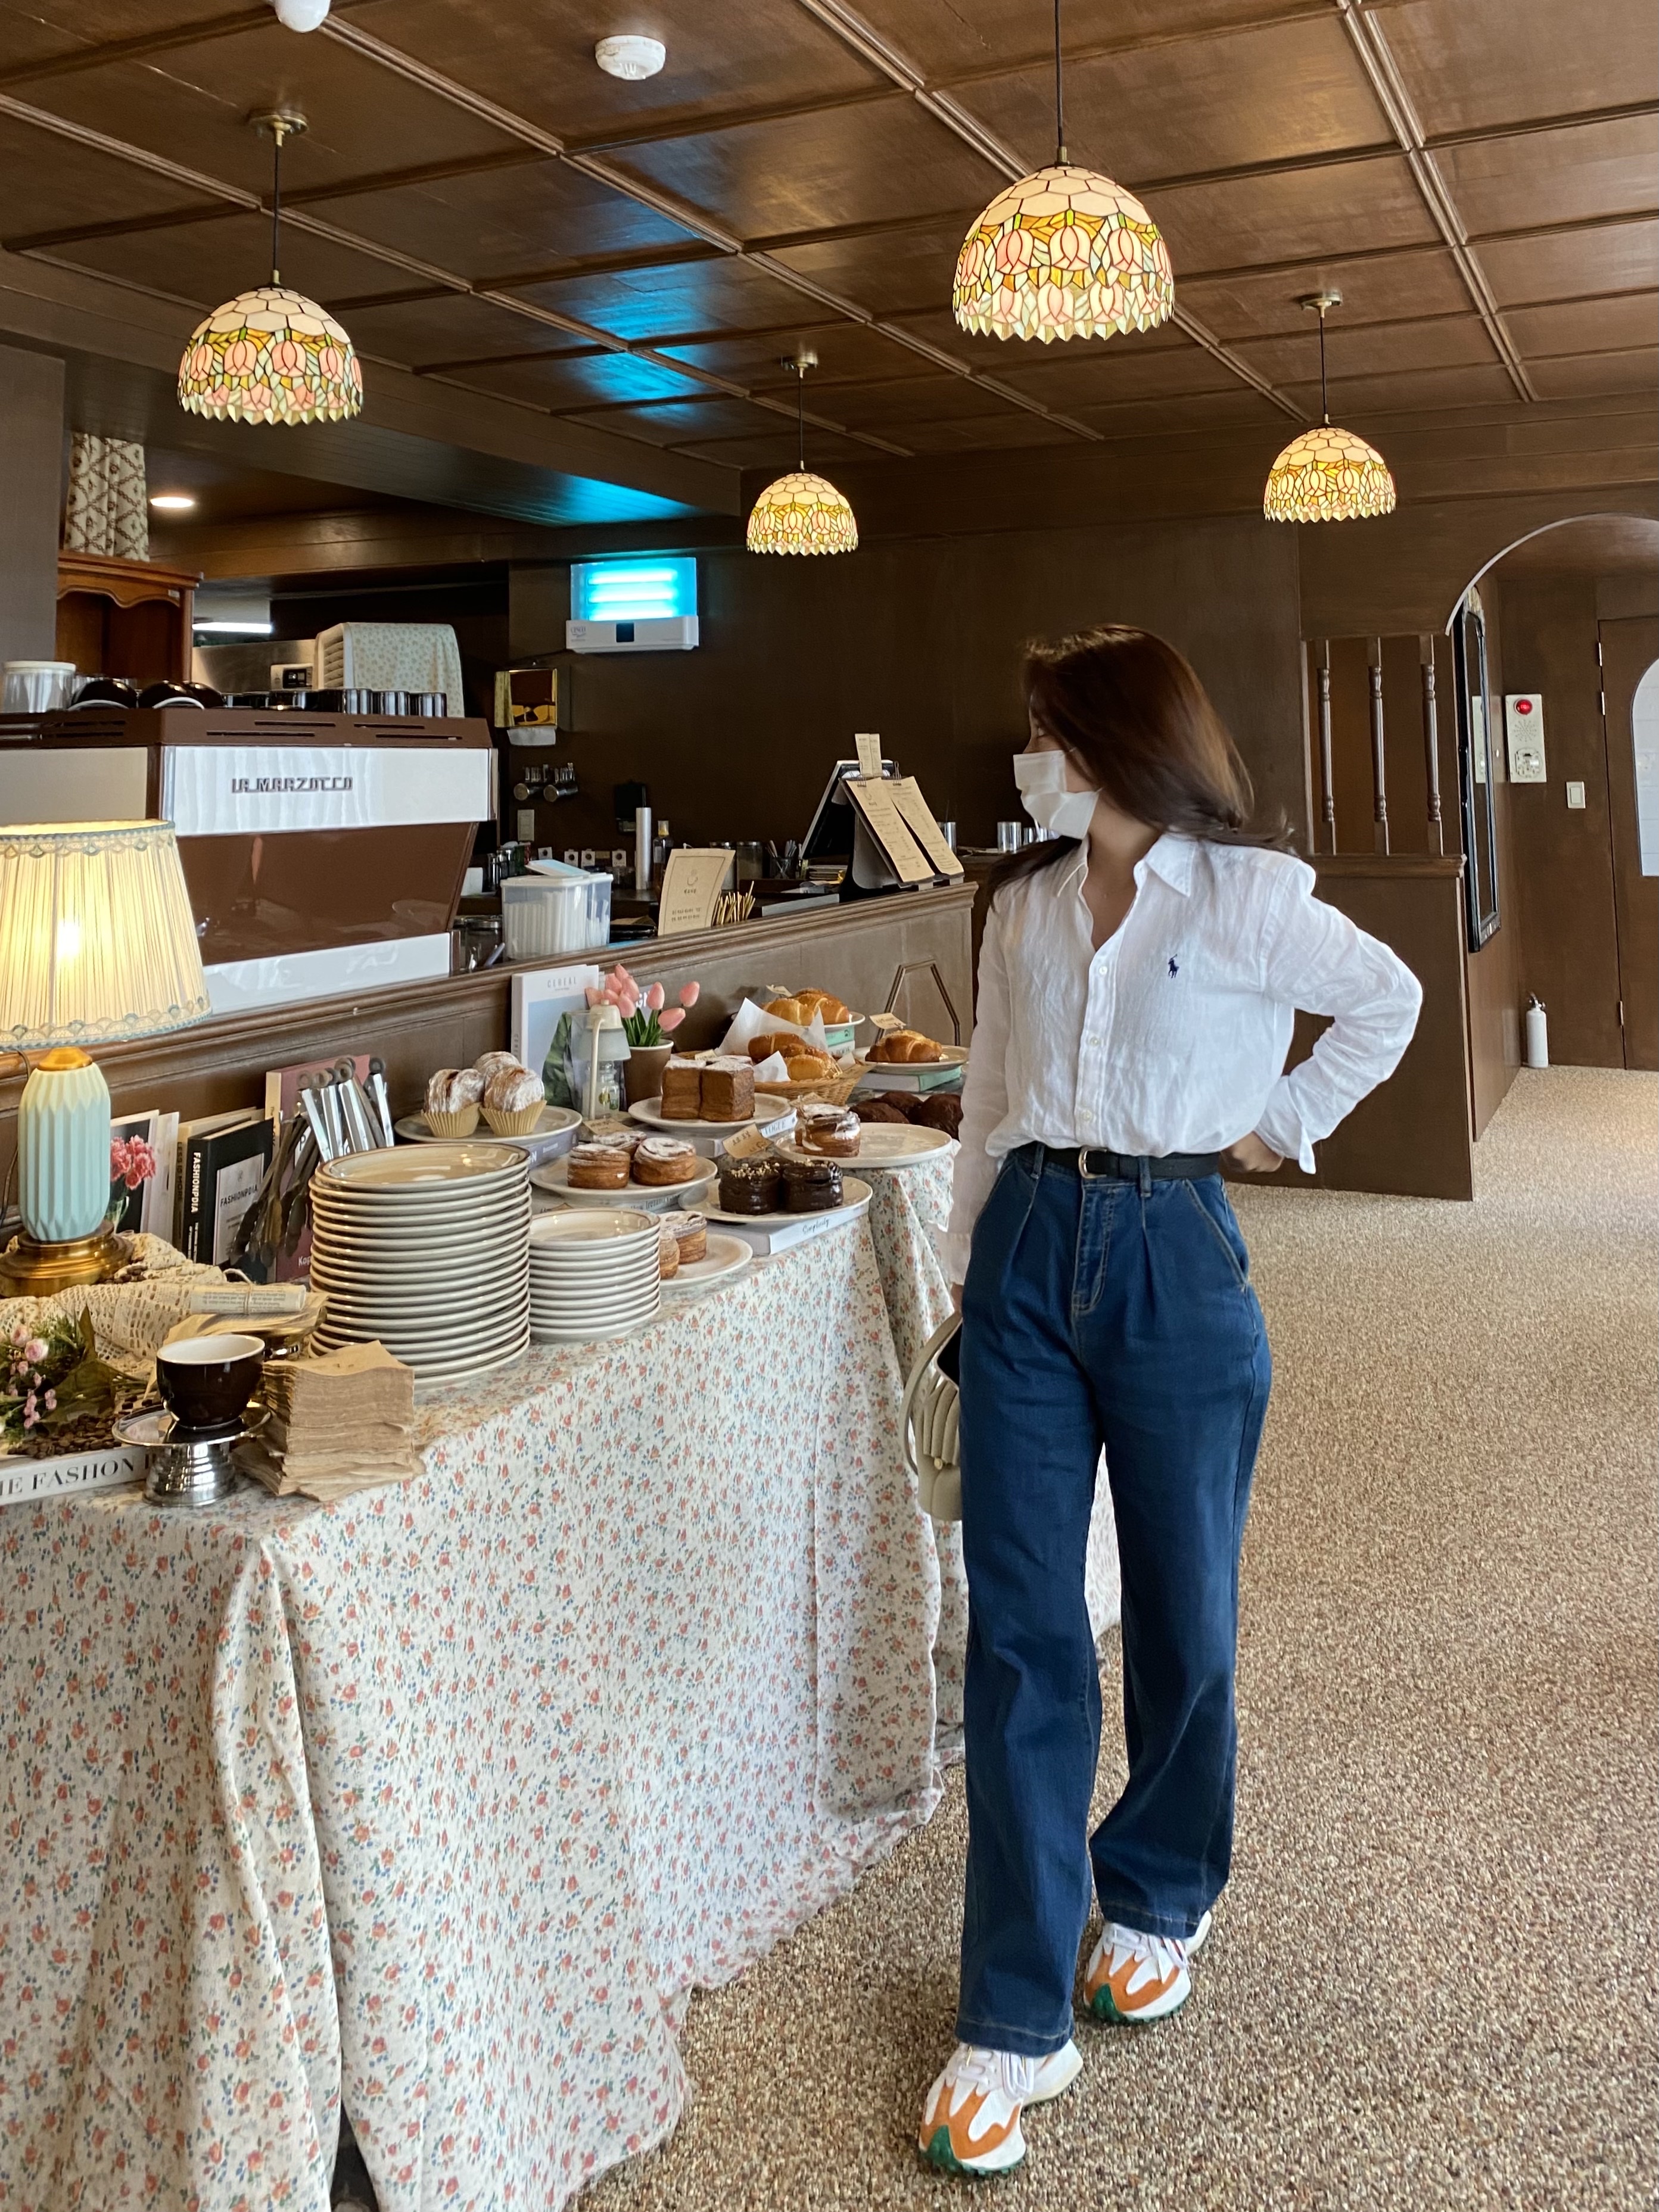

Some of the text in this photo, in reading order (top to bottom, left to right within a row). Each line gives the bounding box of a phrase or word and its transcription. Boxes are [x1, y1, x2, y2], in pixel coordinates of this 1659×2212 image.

[547, 977, 577, 988] CEREAL
[765, 1119, 786, 1135] VOGUE
[191, 1152, 201, 1213] FASHIONPDIA
[220, 1184, 258, 1207] FASHIONPDIA
[32, 1458, 134, 1490] FASHION
